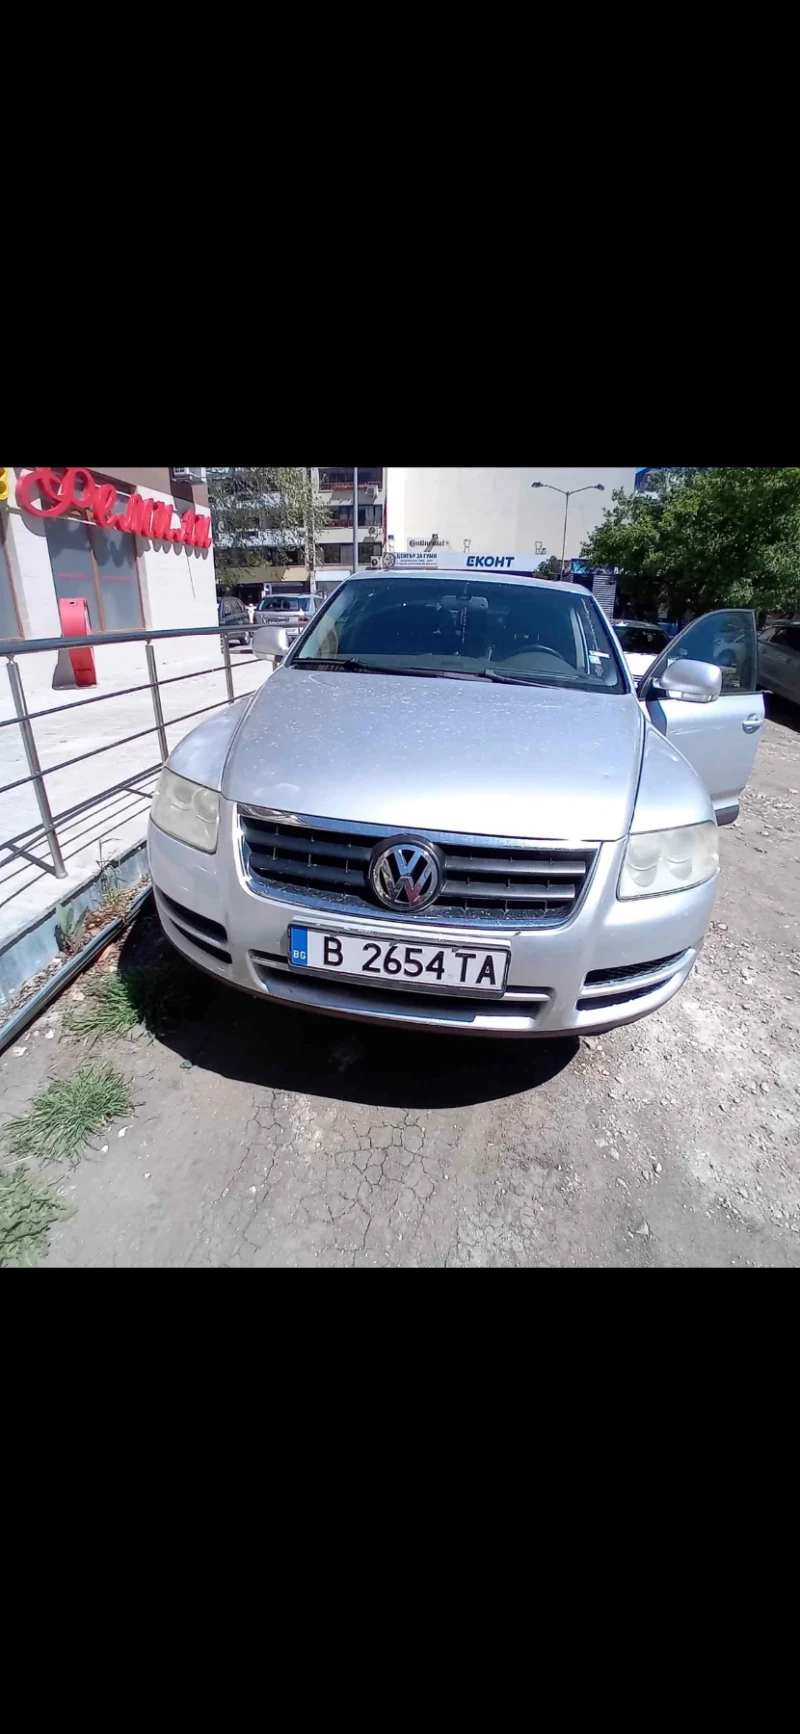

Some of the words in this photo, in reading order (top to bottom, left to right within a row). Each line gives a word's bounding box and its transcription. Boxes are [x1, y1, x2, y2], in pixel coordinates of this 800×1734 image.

[466, 556, 515, 568] ЕКОНТ
[293, 949, 307, 960] BG
[323, 936, 344, 967] B
[361, 942, 446, 981] 2654
[454, 952, 497, 986] TA
